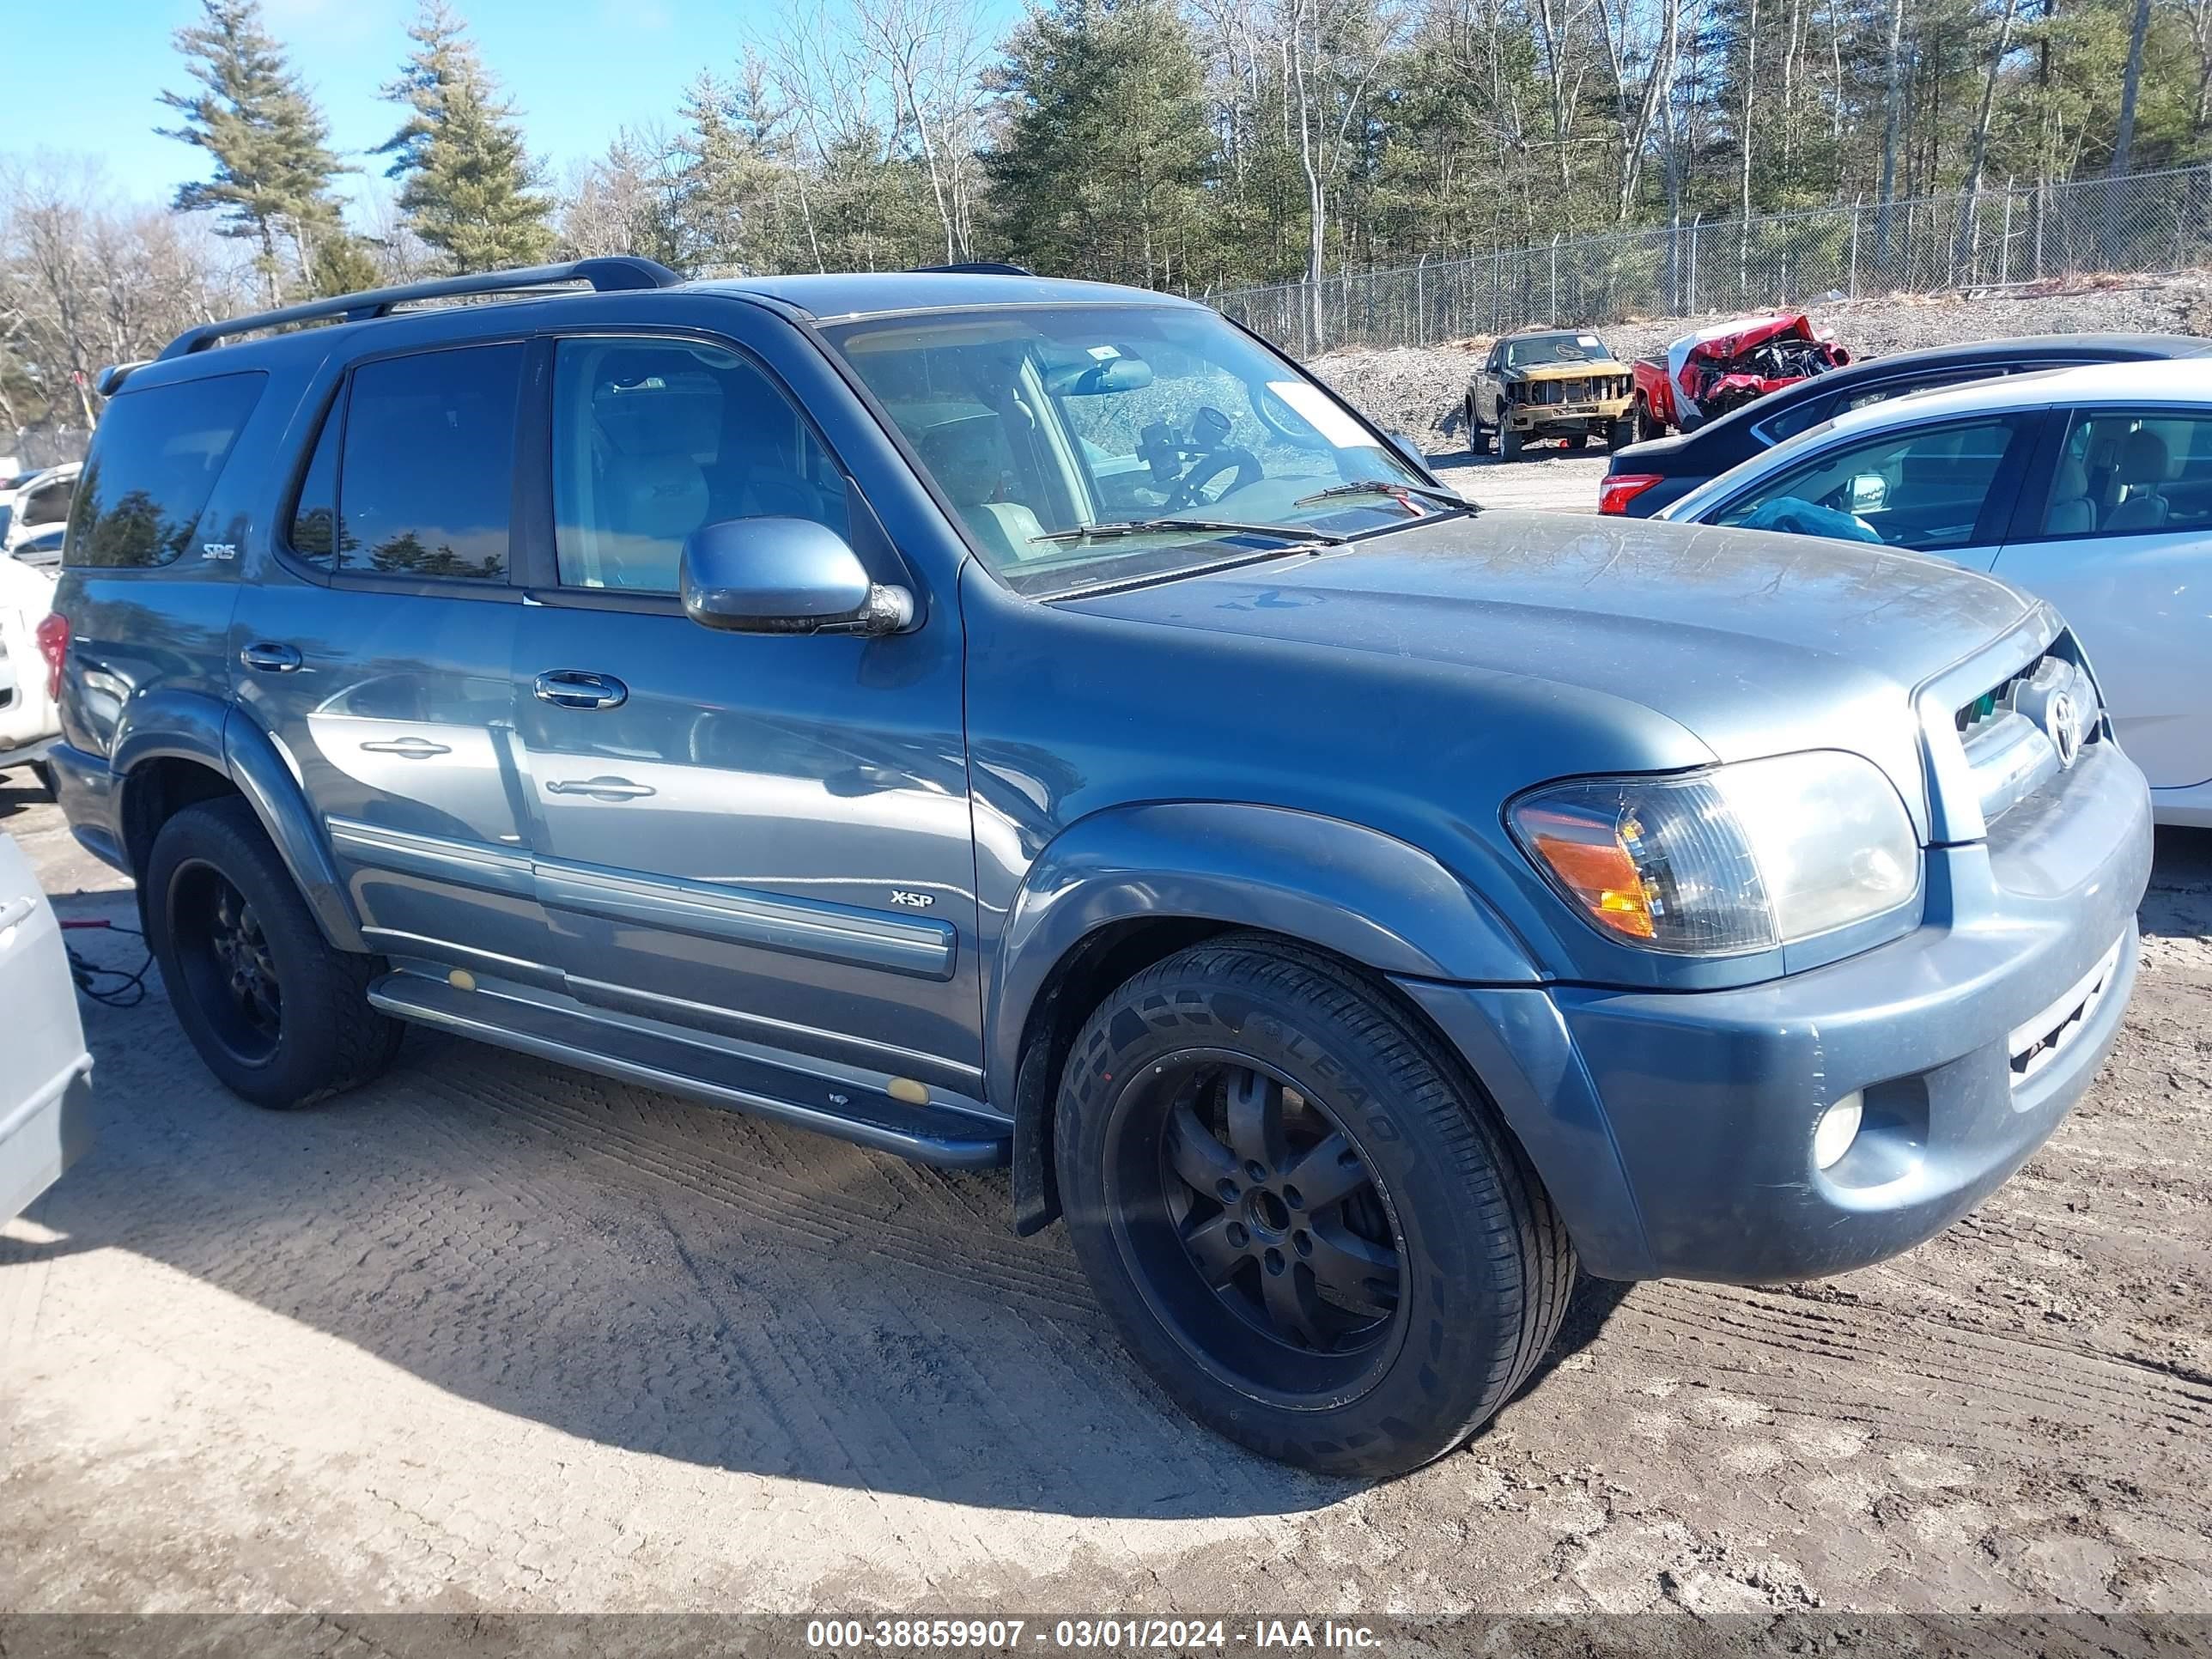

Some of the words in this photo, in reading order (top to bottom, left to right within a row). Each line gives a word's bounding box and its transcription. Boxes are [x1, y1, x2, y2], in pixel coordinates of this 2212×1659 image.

[202, 543, 236, 560] SR5
[890, 890, 934, 908] X-SP
[1284, 1033, 1401, 1142] LEAO
